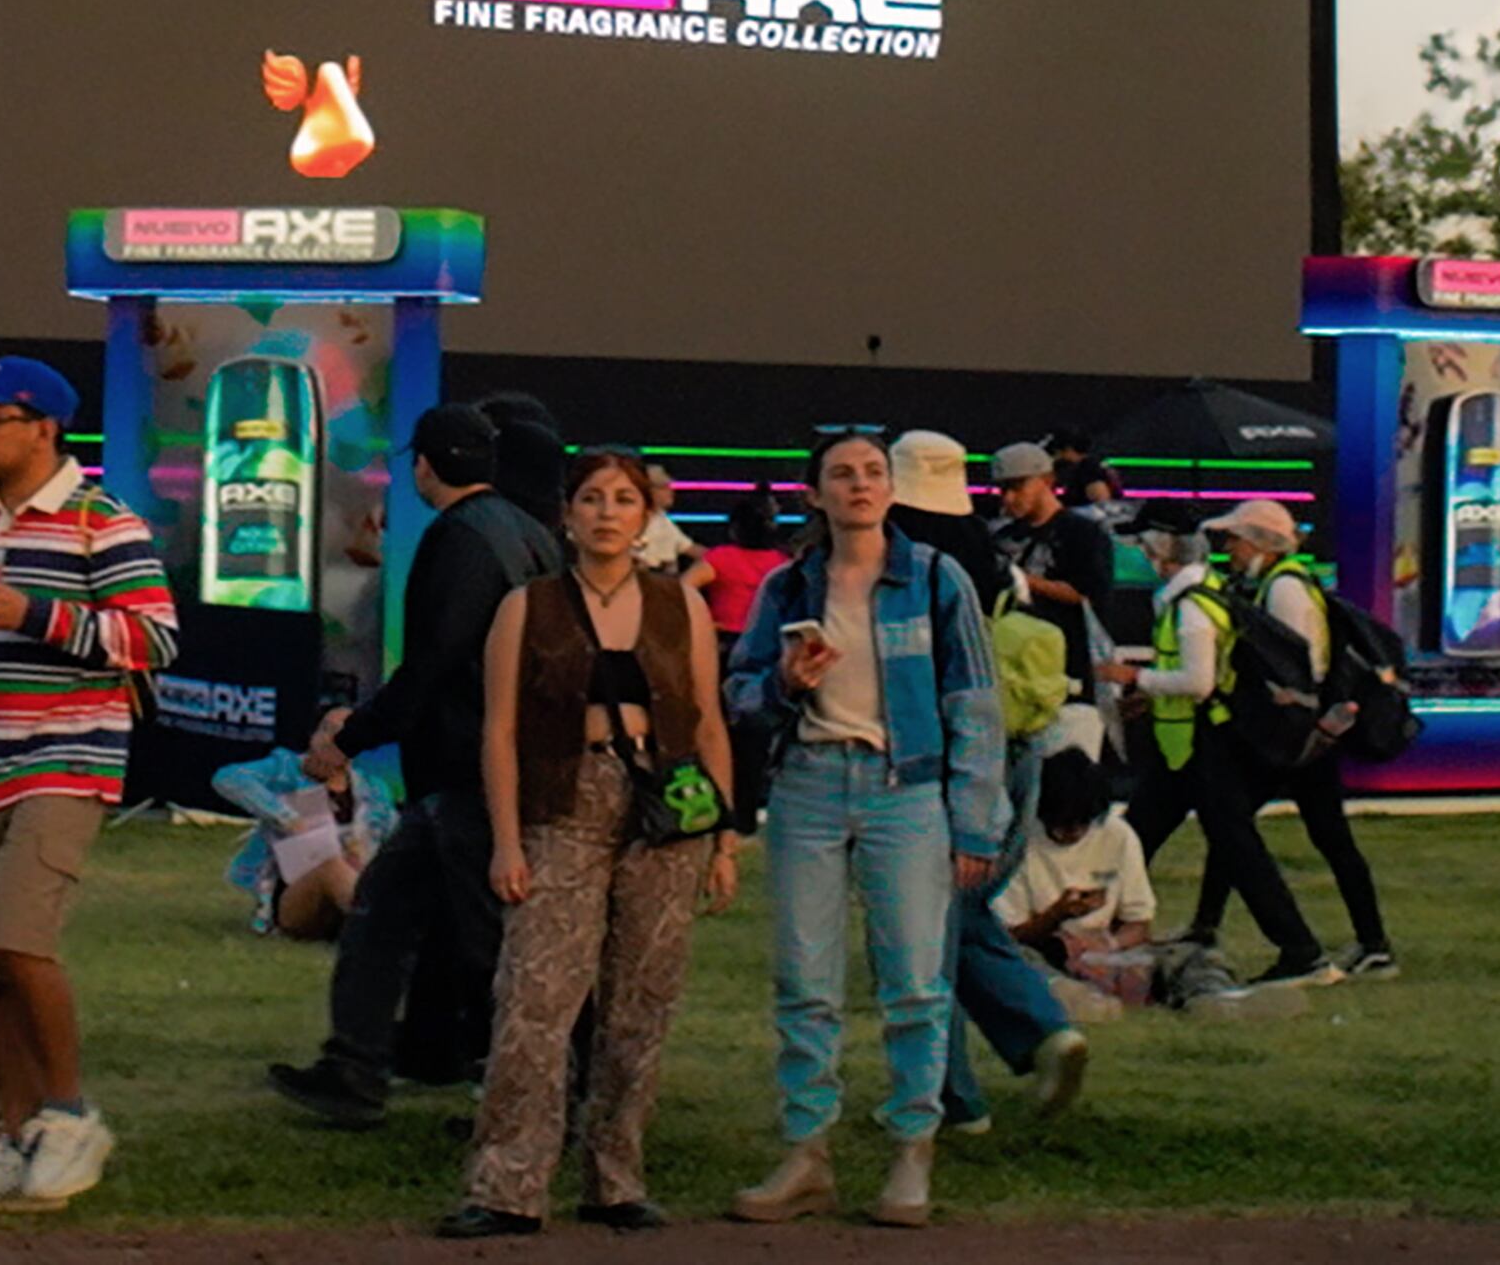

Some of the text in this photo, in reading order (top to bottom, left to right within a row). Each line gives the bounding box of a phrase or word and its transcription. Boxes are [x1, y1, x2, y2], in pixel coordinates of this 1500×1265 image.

[525, 4, 727, 45] FRAGRANCE
[736, 20, 941, 59] COLLECTION
[132, 209, 376, 245] NUEVO AXE
[122, 244, 160, 259] FINE
[165, 244, 266, 259] FRAGRANCE
[220, 483, 296, 505] AXE
[213, 682, 277, 726] AXE
